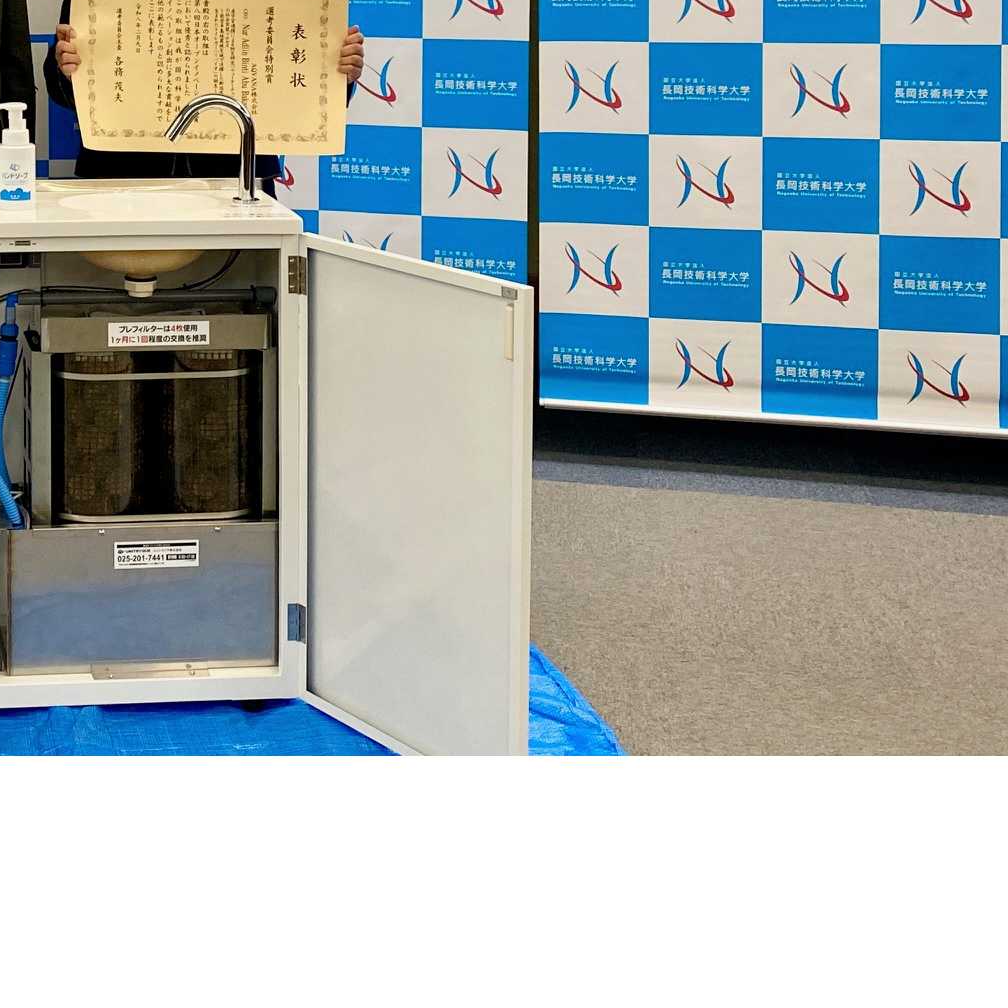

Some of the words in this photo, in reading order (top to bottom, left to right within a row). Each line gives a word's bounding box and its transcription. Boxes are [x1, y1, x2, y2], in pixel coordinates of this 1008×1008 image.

[290, 23, 307, 88] 表彰状
[435, 80, 517, 91] 長岡技術科学大学
[662, 85, 750, 96] 長岡技術科学大学
[894, 88, 988, 99] 長岡技術科学大学
[331, 164, 410, 176] 長岡技術科学大学
[552, 173, 637, 186] 長岡技術科学大学
[775, 180, 866, 192] 長岡技術科学大学
[661, 268, 749, 282] 長岡技術科学大学
[893, 279, 987, 292] 長岡技術科学大学
[552, 353, 637, 368] 長岡技術科学大学
[775, 366, 865, 380] 長岡技術科学大学
